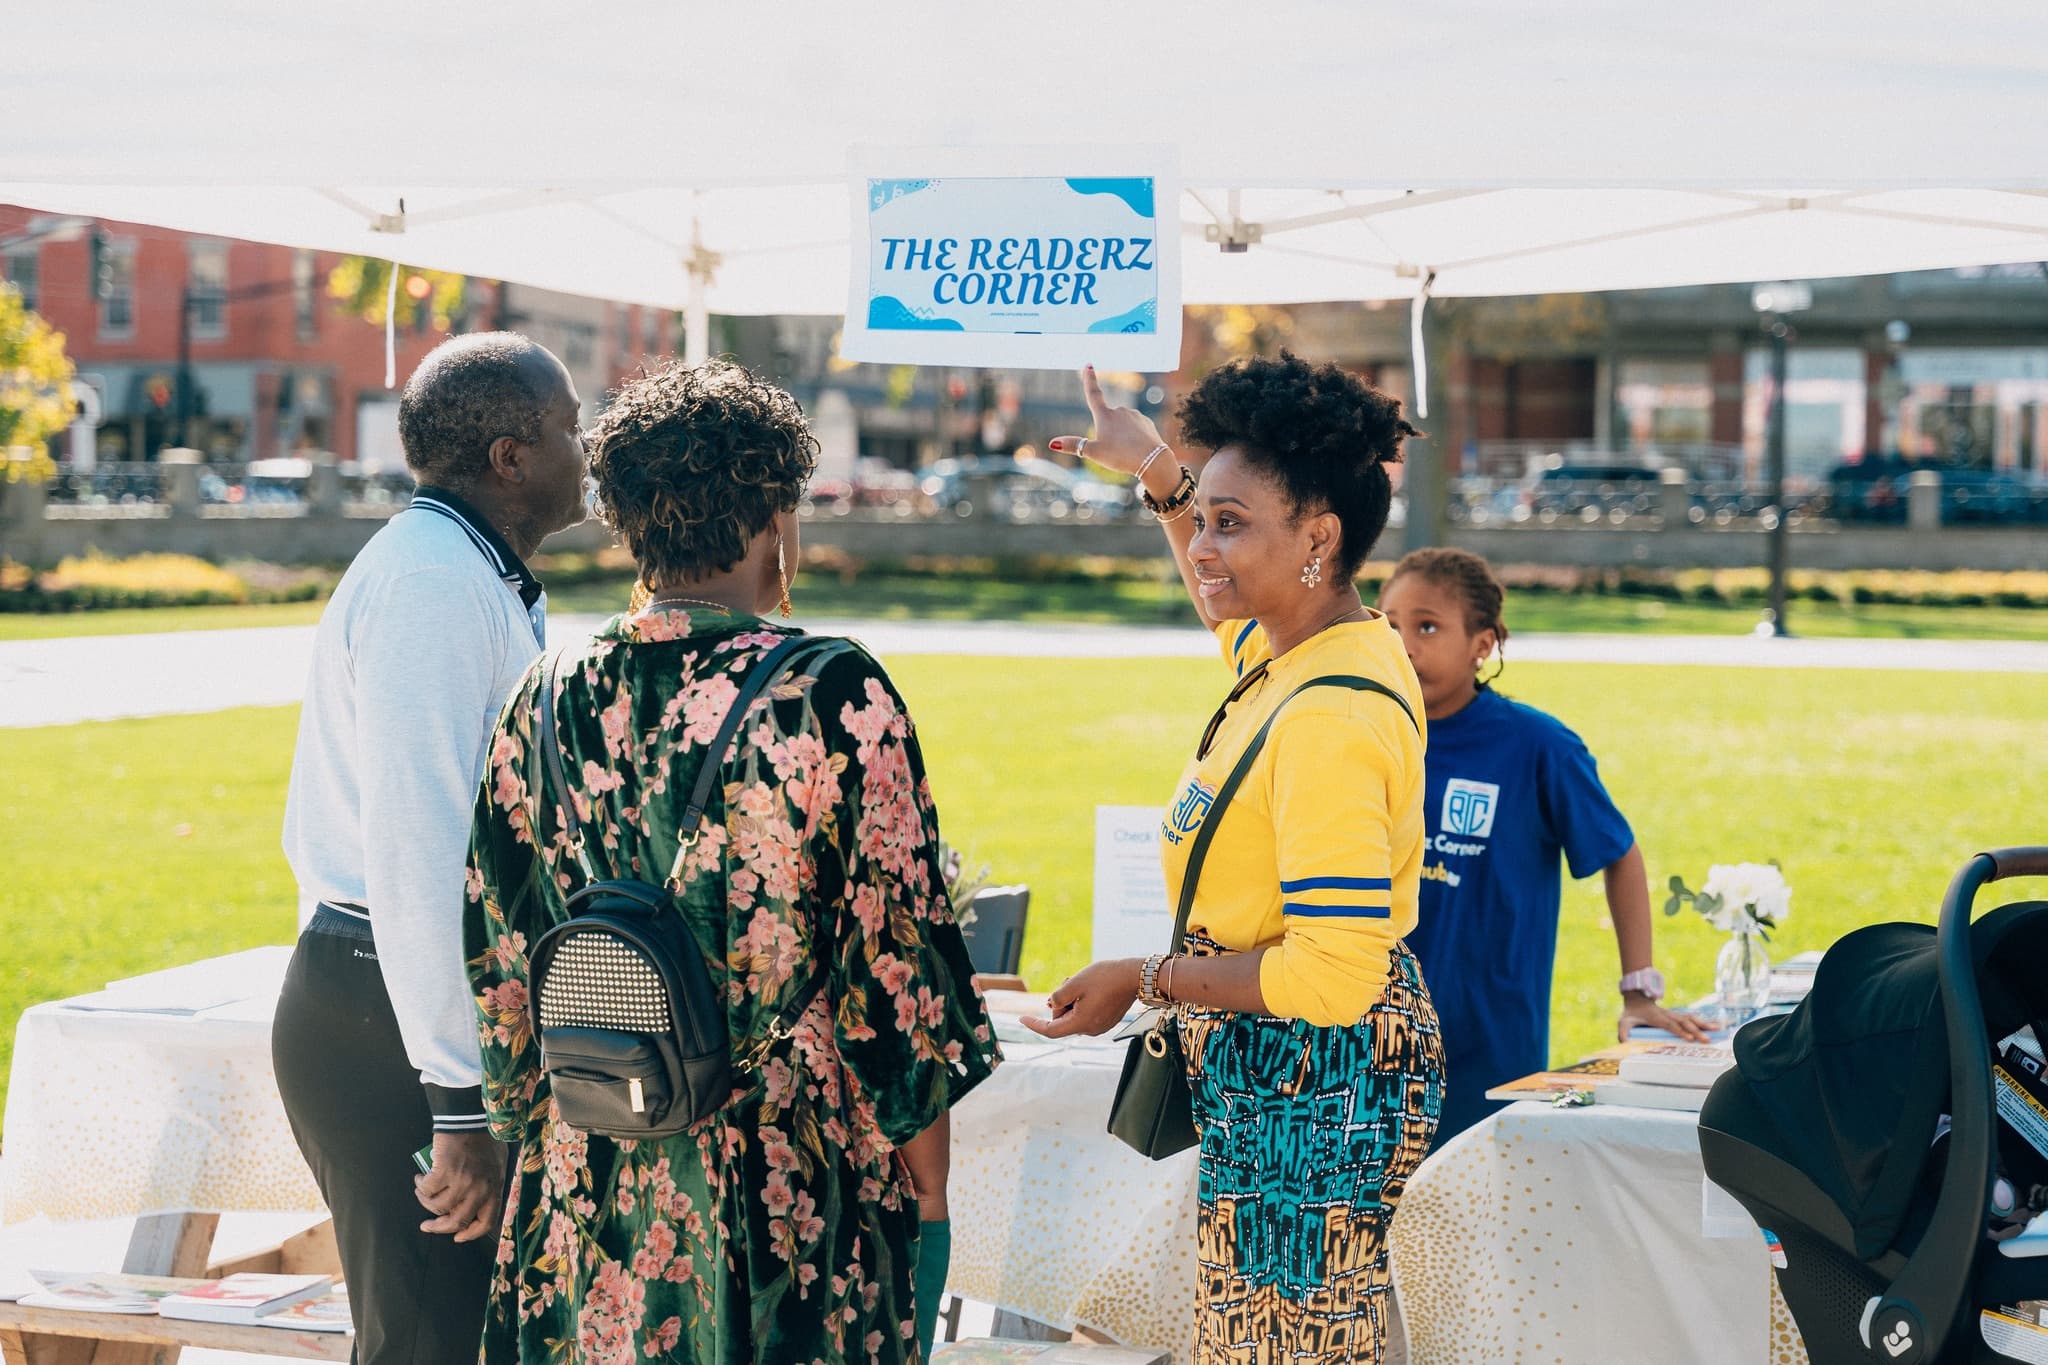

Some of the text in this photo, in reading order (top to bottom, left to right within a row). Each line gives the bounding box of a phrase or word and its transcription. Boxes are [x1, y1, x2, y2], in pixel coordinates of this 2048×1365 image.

[881, 238, 1153, 271] THE READERZ
[933, 272, 1099, 305] CORNER
[1434, 834, 1487, 856] Corner
[2001, 1073, 2030, 1100] WARNING
